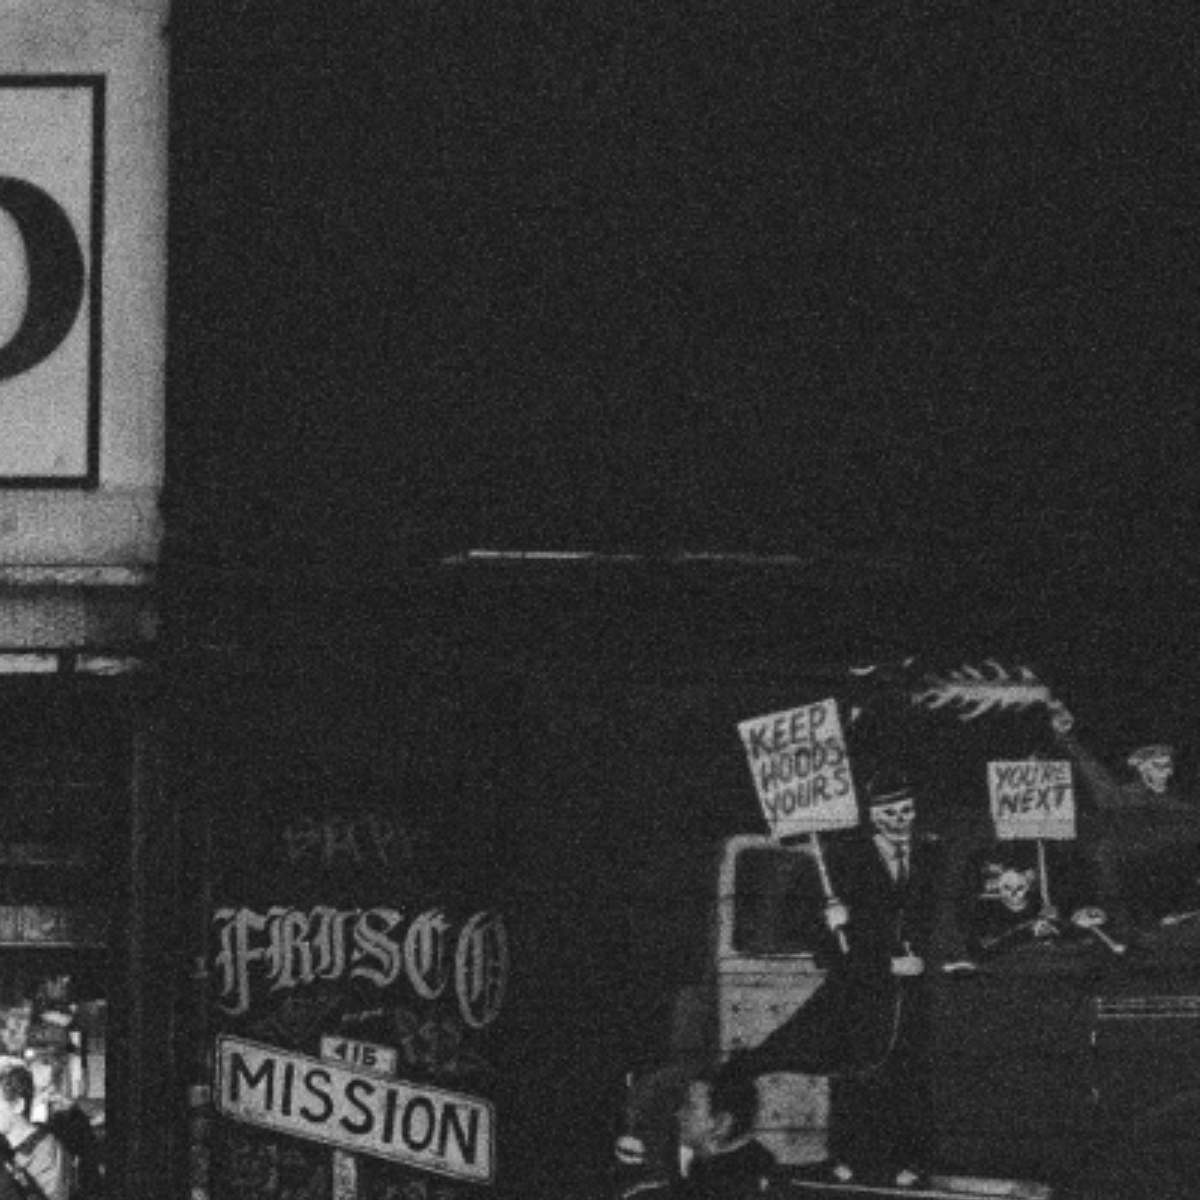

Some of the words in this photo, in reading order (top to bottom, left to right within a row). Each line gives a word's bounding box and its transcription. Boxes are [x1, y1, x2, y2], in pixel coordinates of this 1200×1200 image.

[749, 704, 828, 760] KEEP
[761, 737, 846, 793] HOODS
[764, 767, 851, 823] YOURS
[998, 785, 1068, 817] NEXT
[213, 904, 508, 1029] FRISCO
[333, 1041, 377, 1067] 415
[230, 1052, 479, 1166] MISSION
